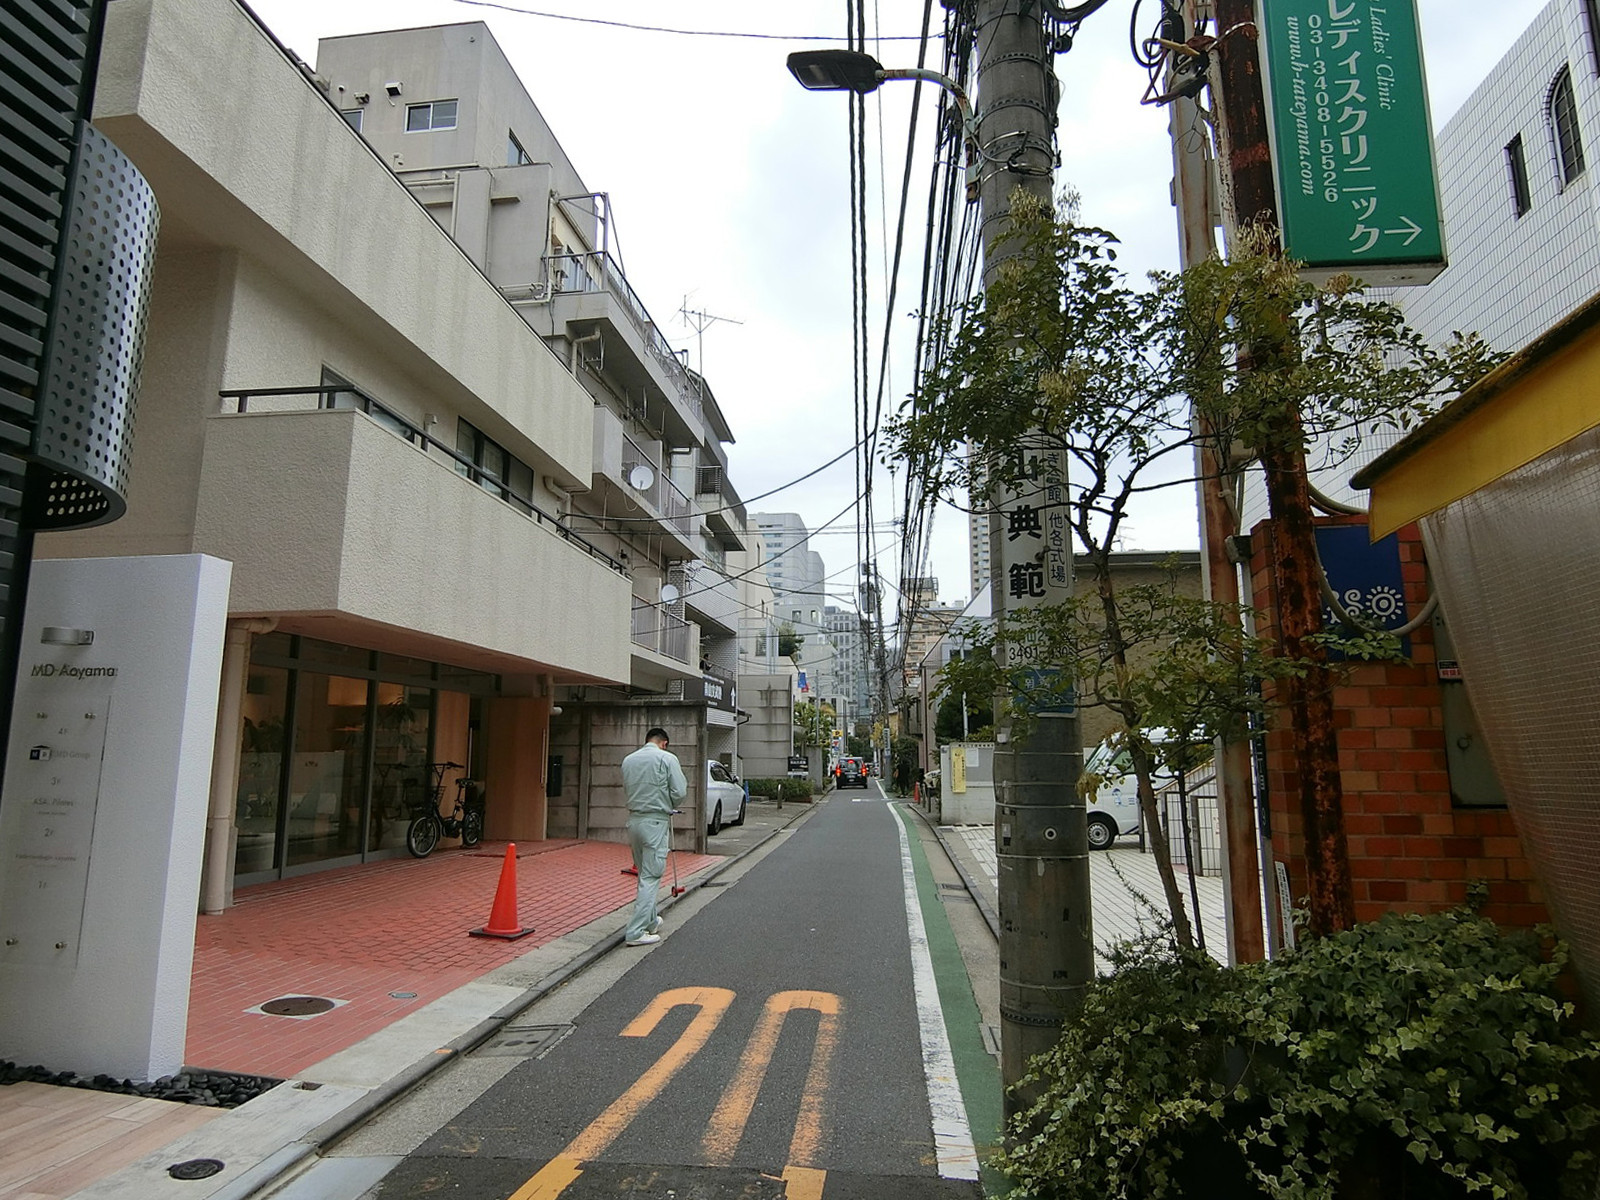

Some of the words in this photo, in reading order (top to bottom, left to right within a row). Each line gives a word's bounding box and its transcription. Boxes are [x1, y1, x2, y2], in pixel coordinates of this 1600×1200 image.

[1286, 16, 1315, 195] www.h-tateyama.com
[1308, 14, 1339, 203] 03-3408-5526
[1376, 63, 1396, 111] Clinic
[31, 664, 55, 677] MD
[59, 665, 116, 680] Aoyama
